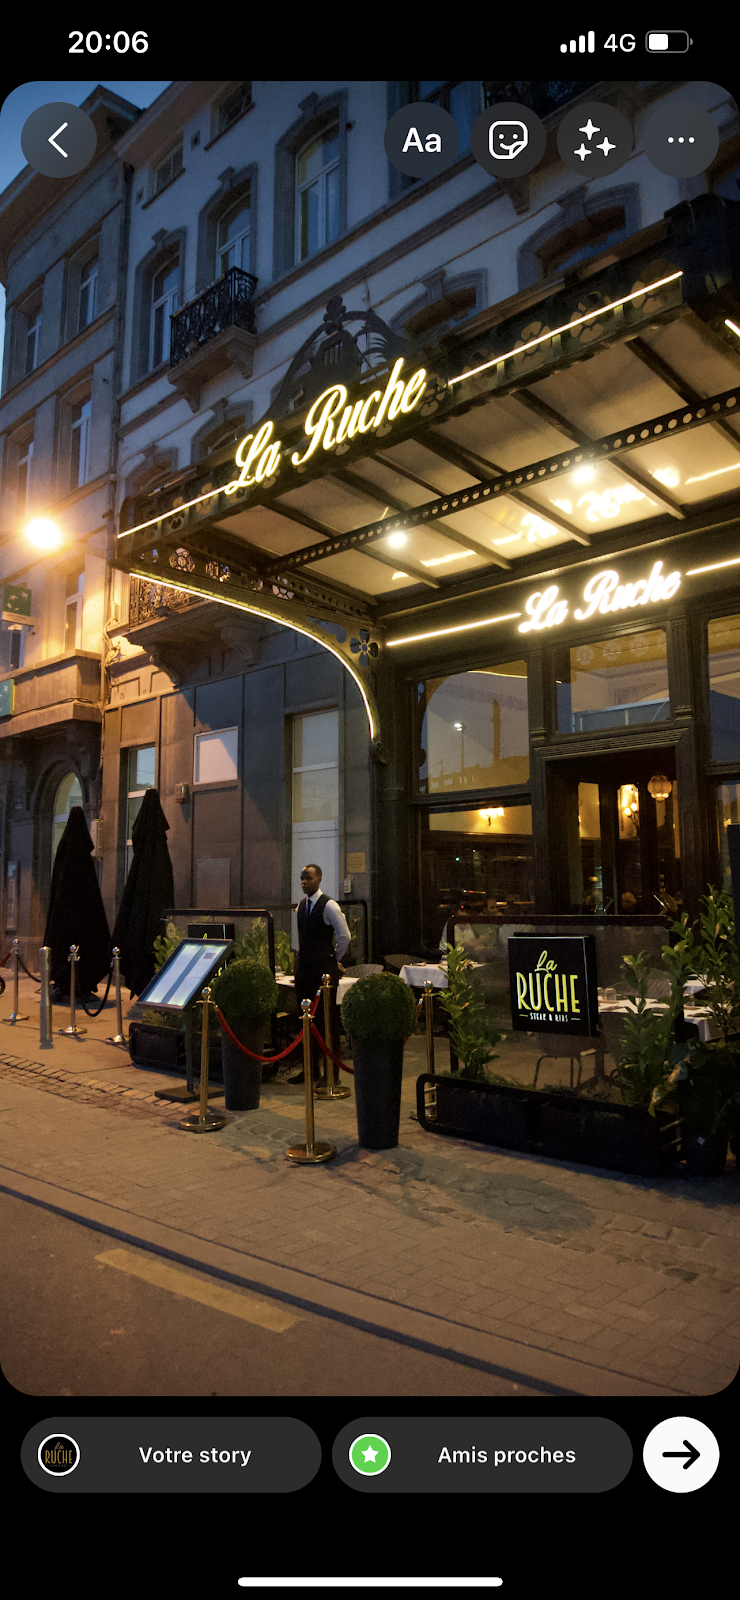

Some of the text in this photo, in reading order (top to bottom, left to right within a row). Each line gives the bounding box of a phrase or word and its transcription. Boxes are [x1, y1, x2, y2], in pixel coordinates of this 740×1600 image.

[225, 356, 427, 495] La Ruche
[518, 560, 682, 634] La Ruche
[534, 950, 558, 973] La
[516, 972, 580, 1013] RUCHE
